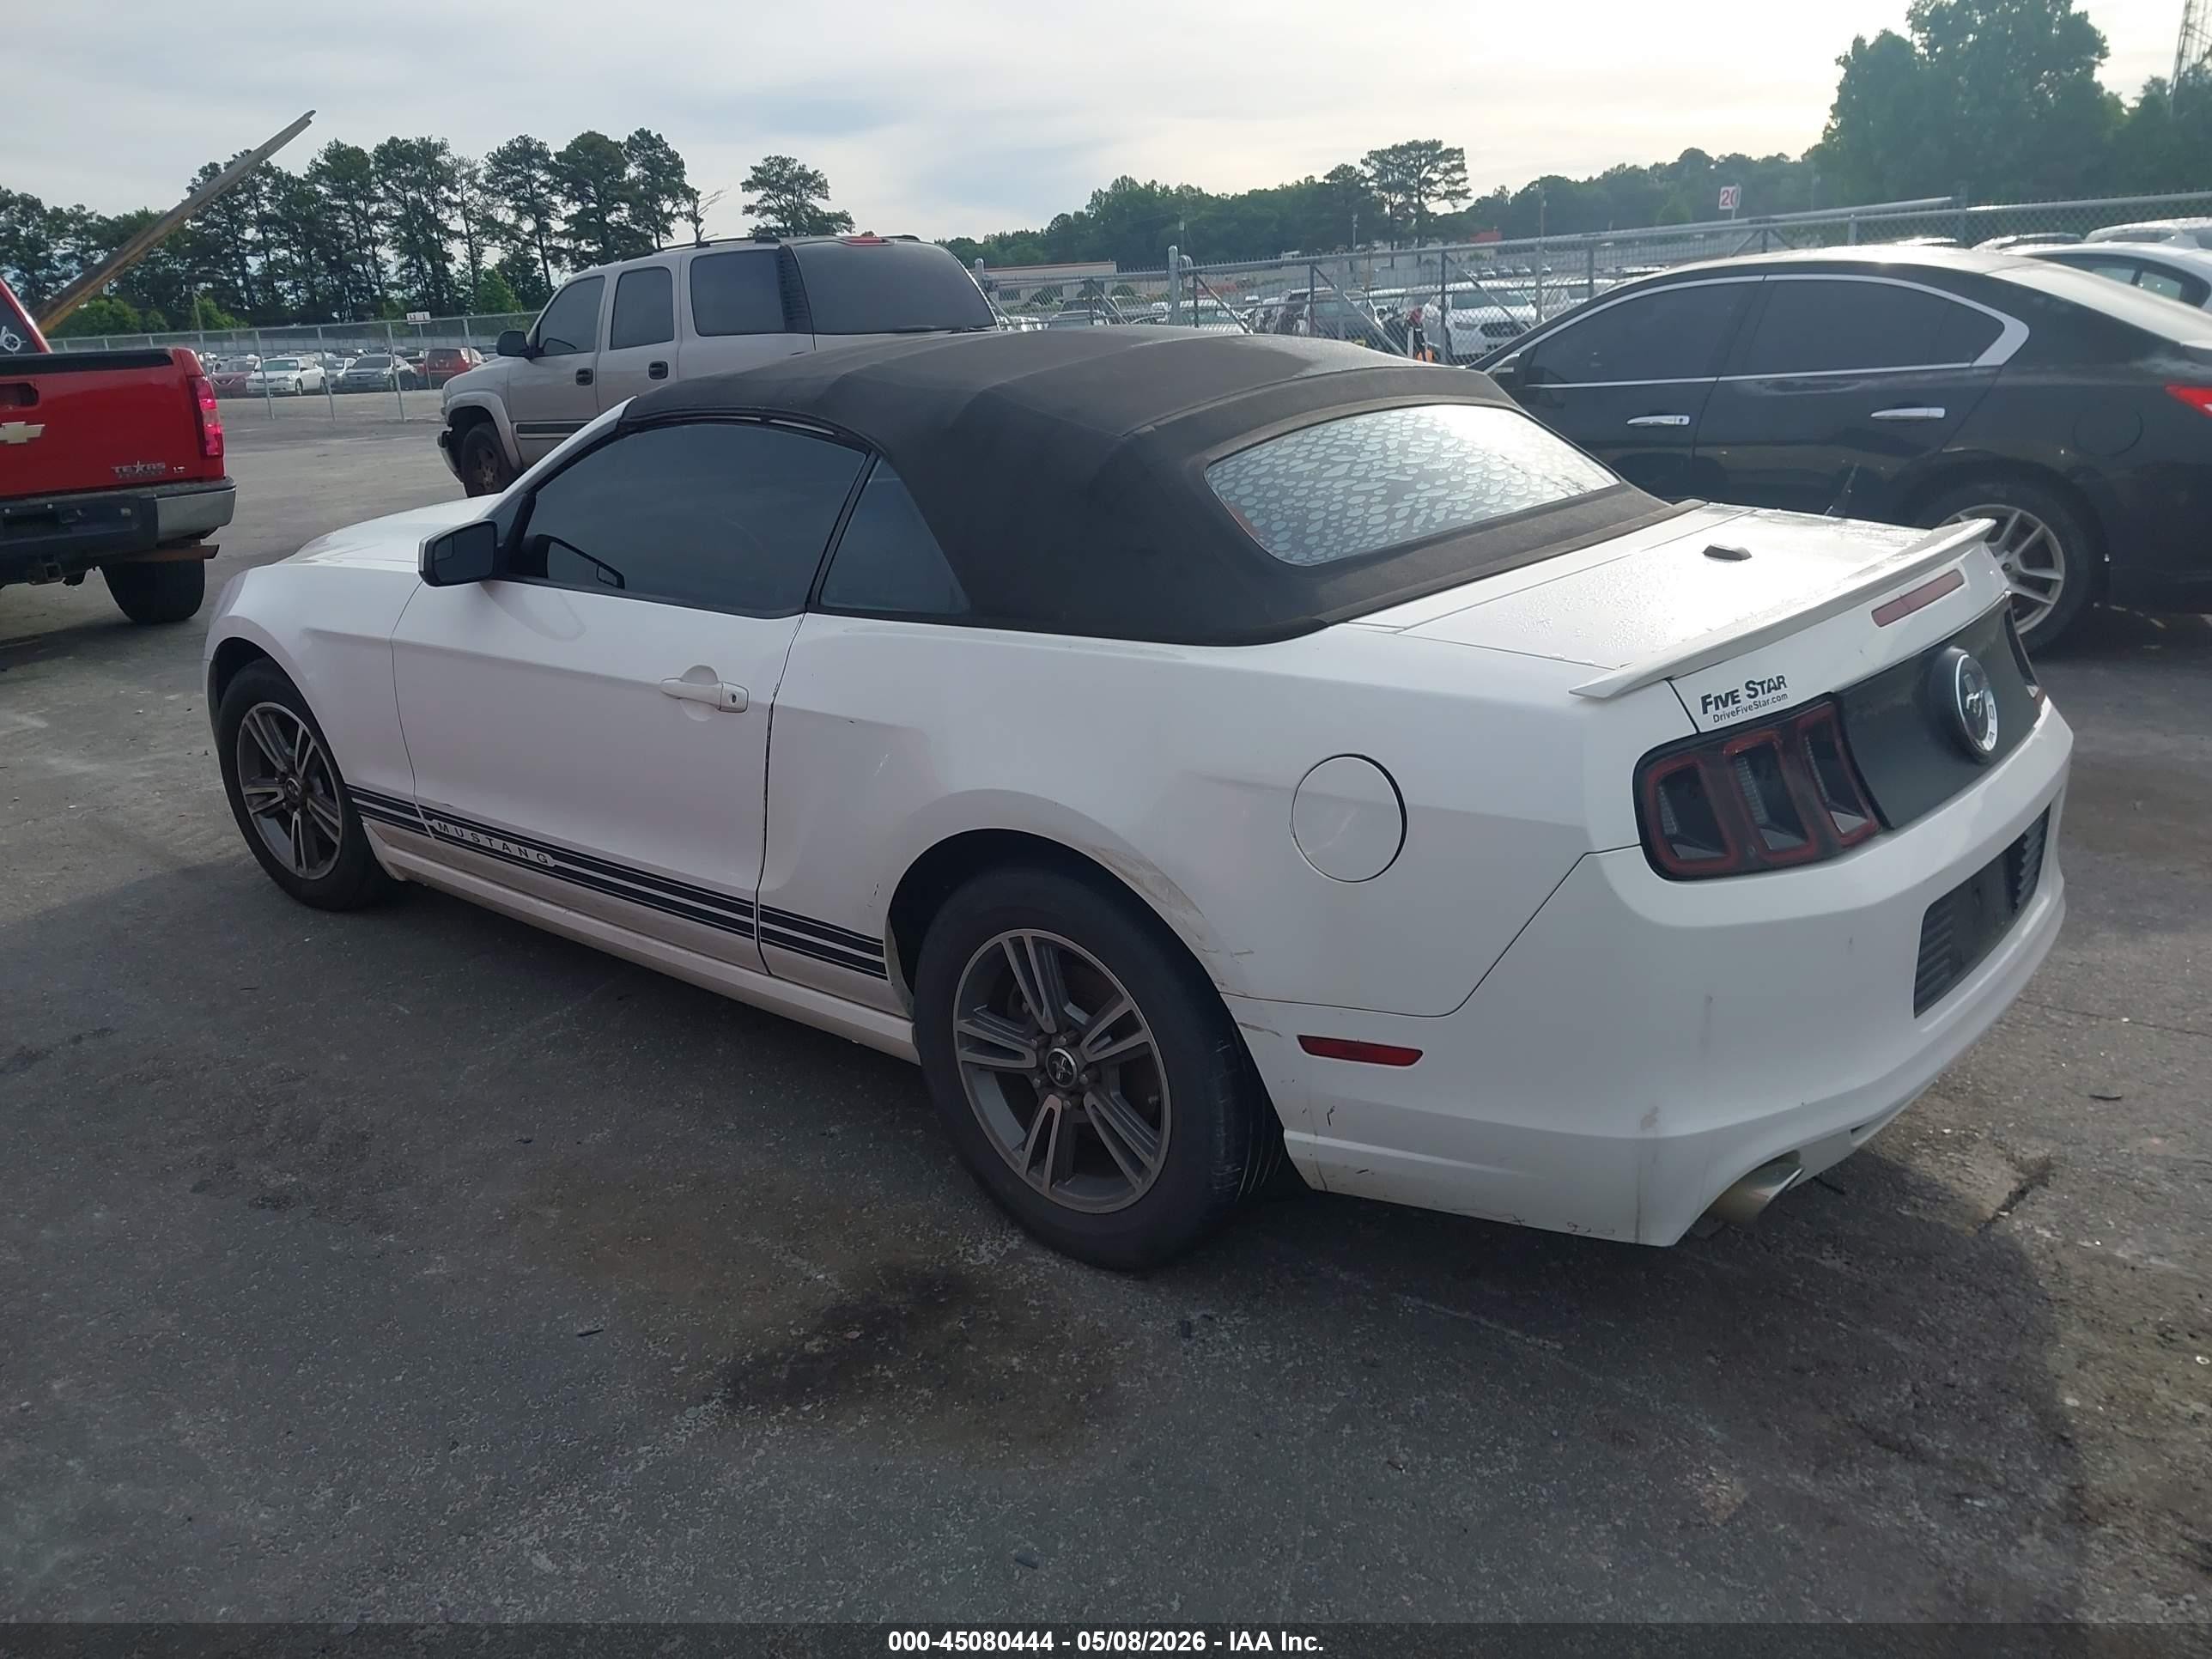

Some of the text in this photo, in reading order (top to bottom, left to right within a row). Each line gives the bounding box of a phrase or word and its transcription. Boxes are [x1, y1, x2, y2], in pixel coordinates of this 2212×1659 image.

[1700, 674, 1788, 715] FIVE STAR
[1712, 693, 1789, 724] DriveFiveStar.com
[437, 821, 549, 864] MUSTANG
